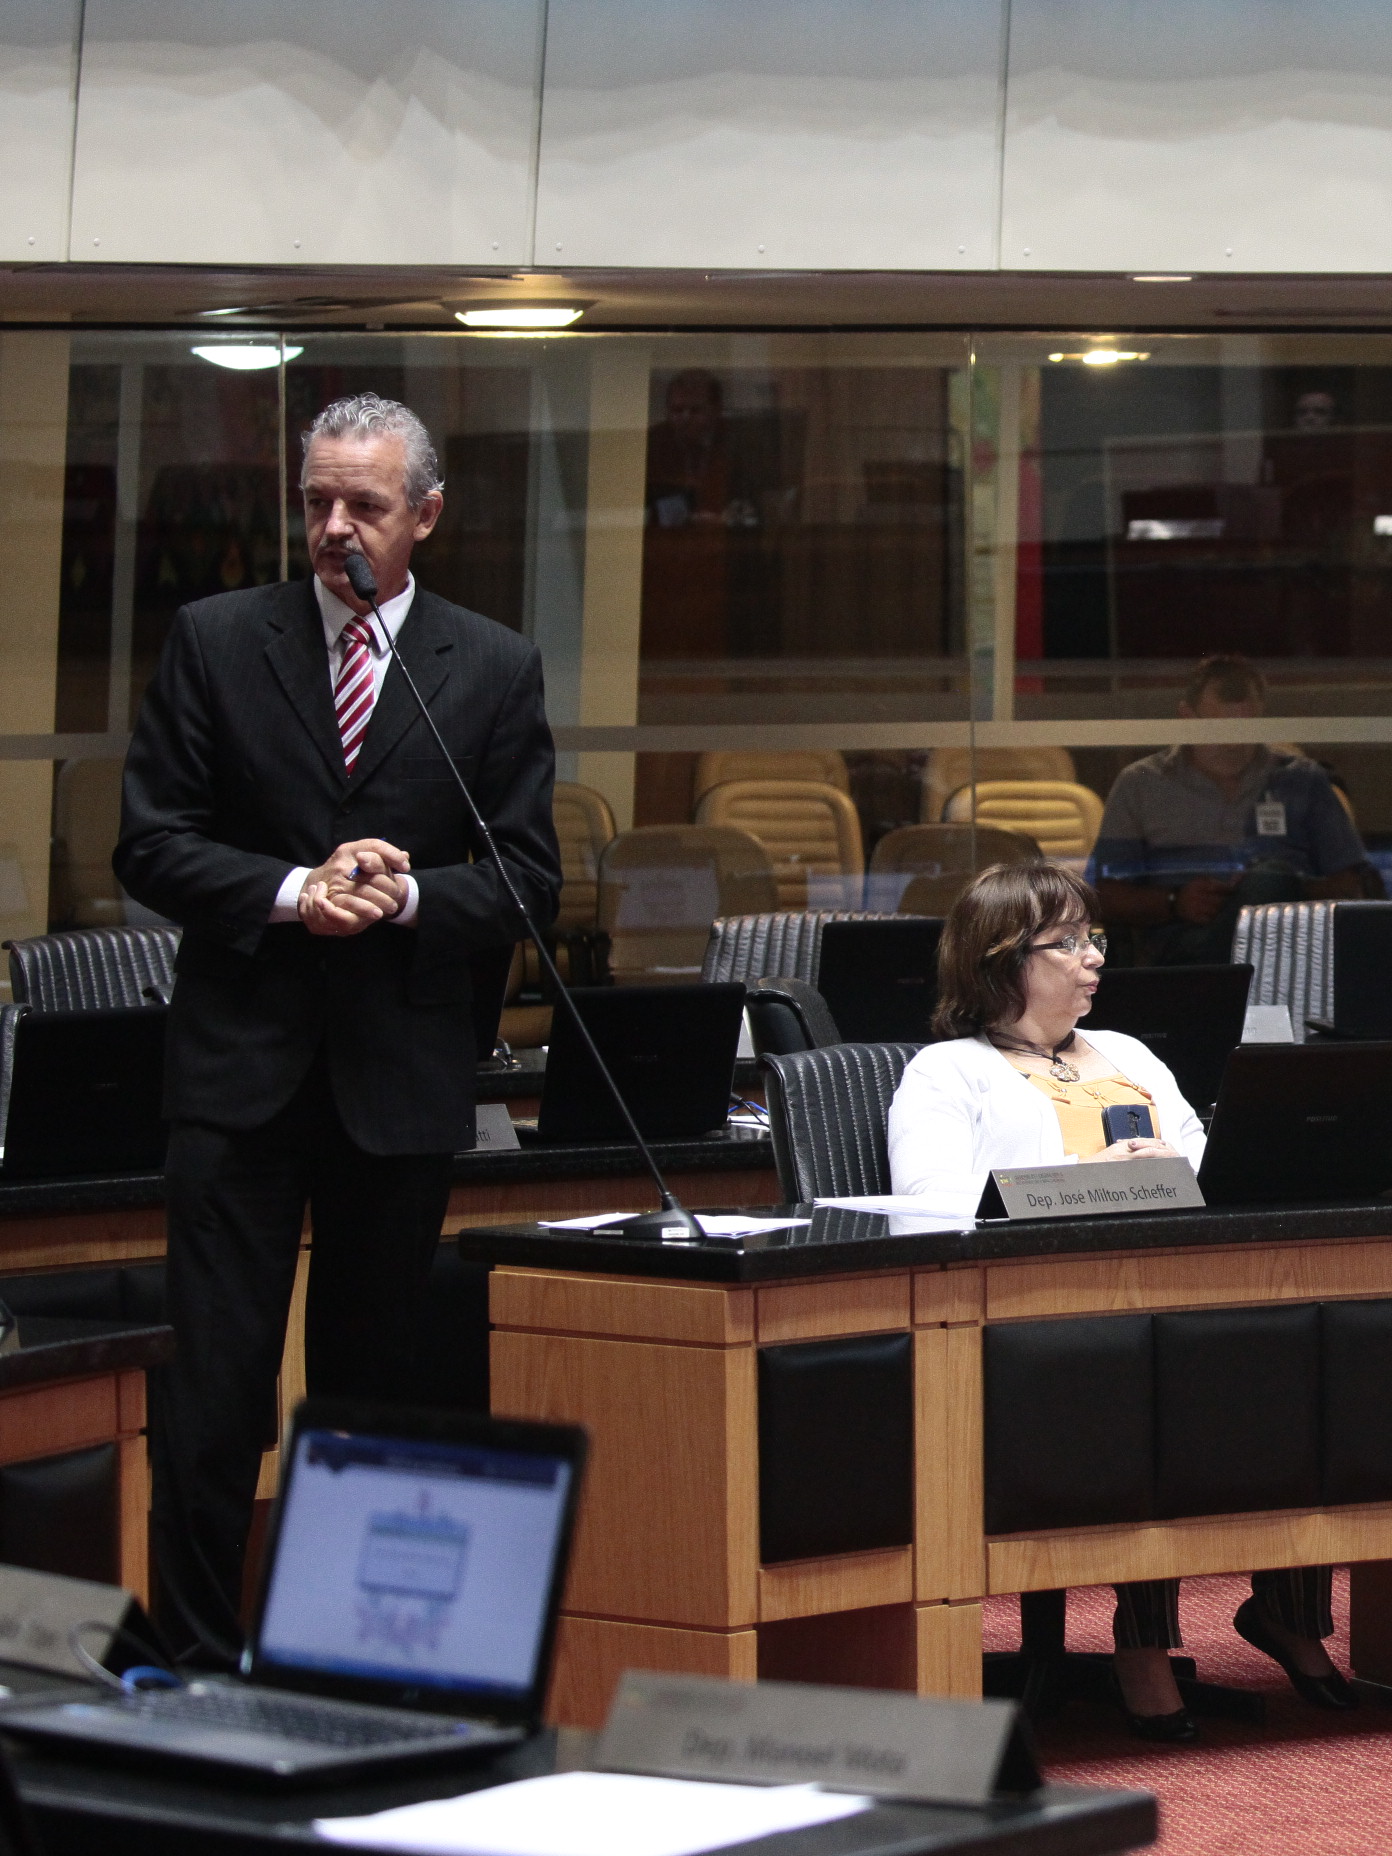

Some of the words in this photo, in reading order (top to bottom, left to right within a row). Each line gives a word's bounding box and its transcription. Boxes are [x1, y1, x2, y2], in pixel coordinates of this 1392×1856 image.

[1026, 1193, 1057, 1209] Dep.
[1059, 1189, 1085, 1206] José
[1087, 1187, 1127, 1204] Milton
[1130, 1183, 1178, 1201] Scheffer
